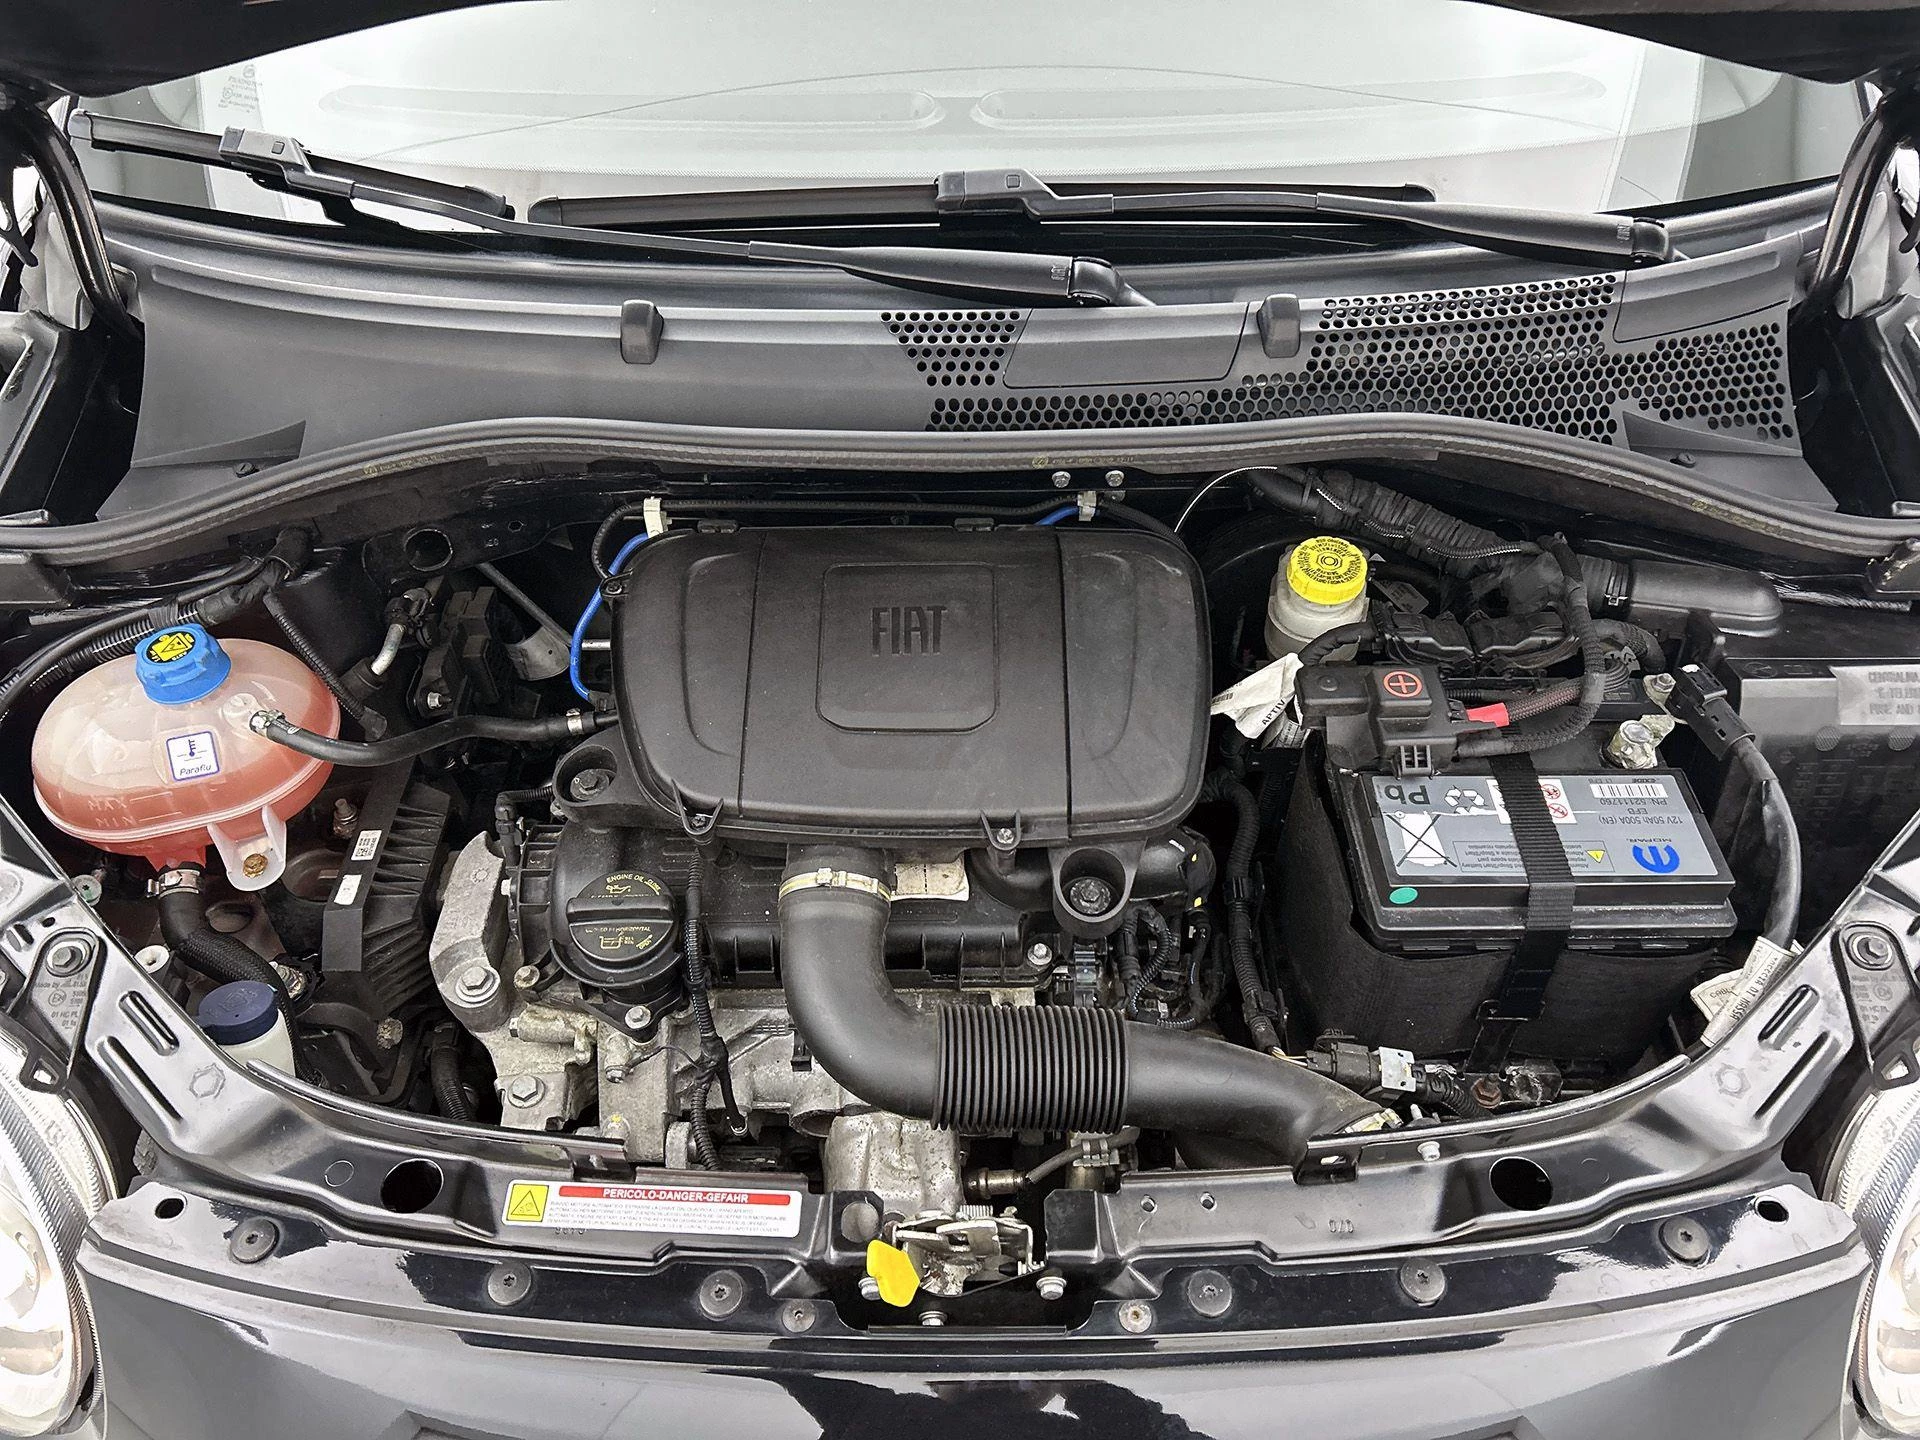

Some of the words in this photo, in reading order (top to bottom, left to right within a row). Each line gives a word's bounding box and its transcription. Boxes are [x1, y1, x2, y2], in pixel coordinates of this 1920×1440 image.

[870, 606, 948, 657] FIAT
[1261, 699, 1286, 726] APTIV
[179, 764, 212, 776] Paraflu
[1384, 784, 1431, 806] Pb
[88, 798, 127, 811] MAX
[1627, 807, 1648, 815] EFB
[95, 815, 136, 828] MIN
[1598, 815, 1617, 825] (EN)
[1619, 816, 1641, 825] 500A
[1642, 816, 1664, 825] 50Ah
[1666, 816, 1683, 825] 12V
[606, 873, 633, 884] ENGINE
[633, 874, 645, 883] OIL
[1746, 986, 1759, 997] DI
[1729, 997, 1751, 1021] MASSA
[602, 1188, 749, 1204] PERICOLO-DANGER-GEFAHR
